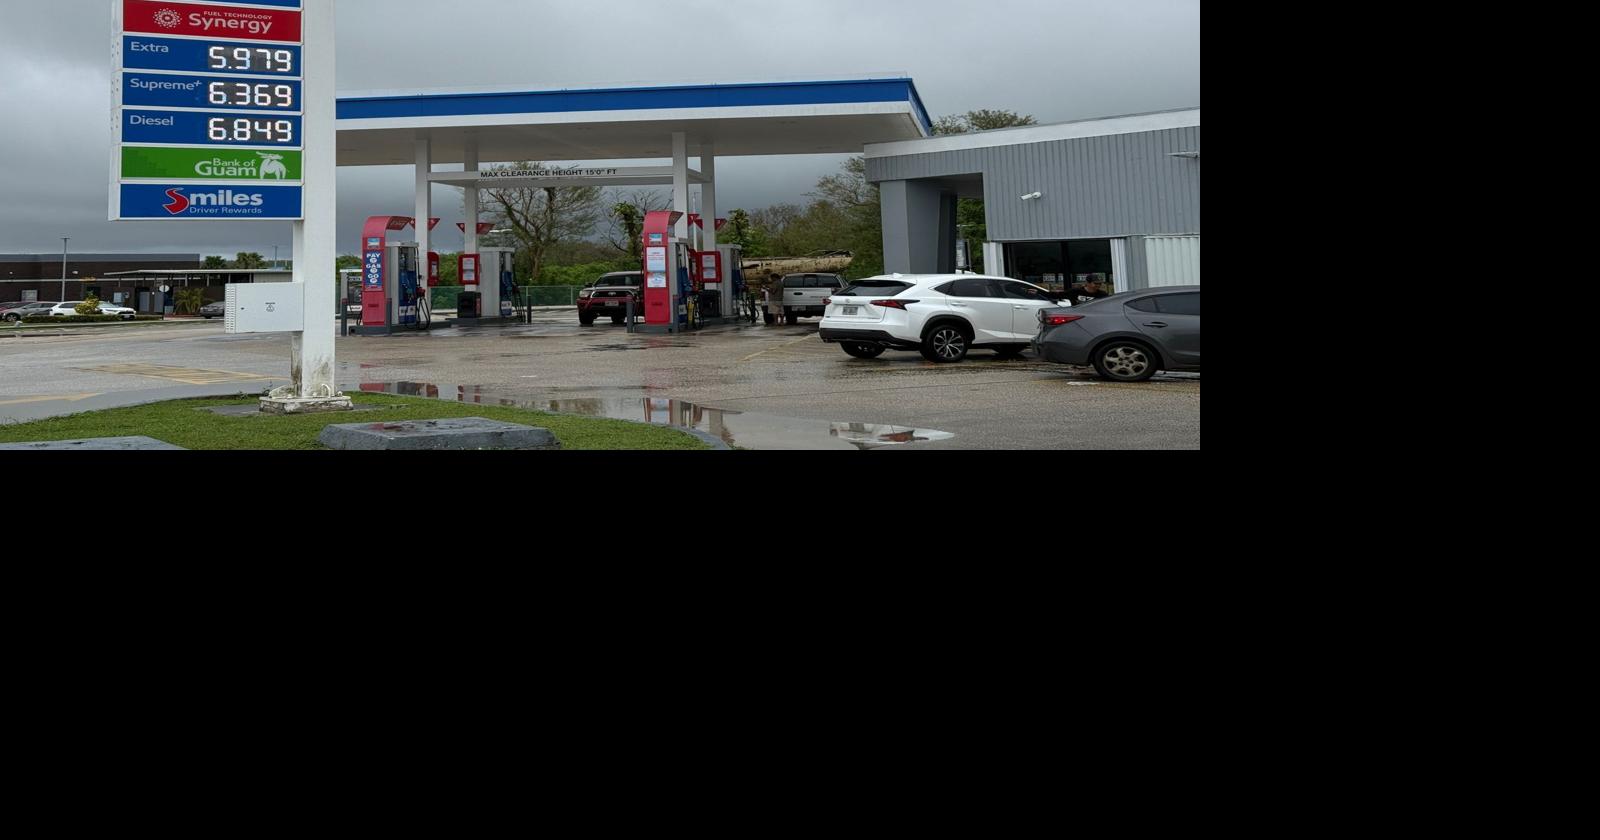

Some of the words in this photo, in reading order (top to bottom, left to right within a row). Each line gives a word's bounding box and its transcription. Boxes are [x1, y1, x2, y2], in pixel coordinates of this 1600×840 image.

[224, 12, 272, 20] TECHNOLOGY
[188, 13, 272, 34] Synergy
[130, 41, 169, 53] Extra
[208, 46, 292, 72] 5.979
[208, 81, 292, 107] 6.369
[130, 115, 173, 126] Diesel
[208, 118, 292, 142] 6.849
[194, 161, 257, 176] Guam
[213, 158, 240, 167] Bank
[242, 159, 256, 167] of
[189, 206, 219, 214] Driver
[222, 206, 262, 214] Rewards
